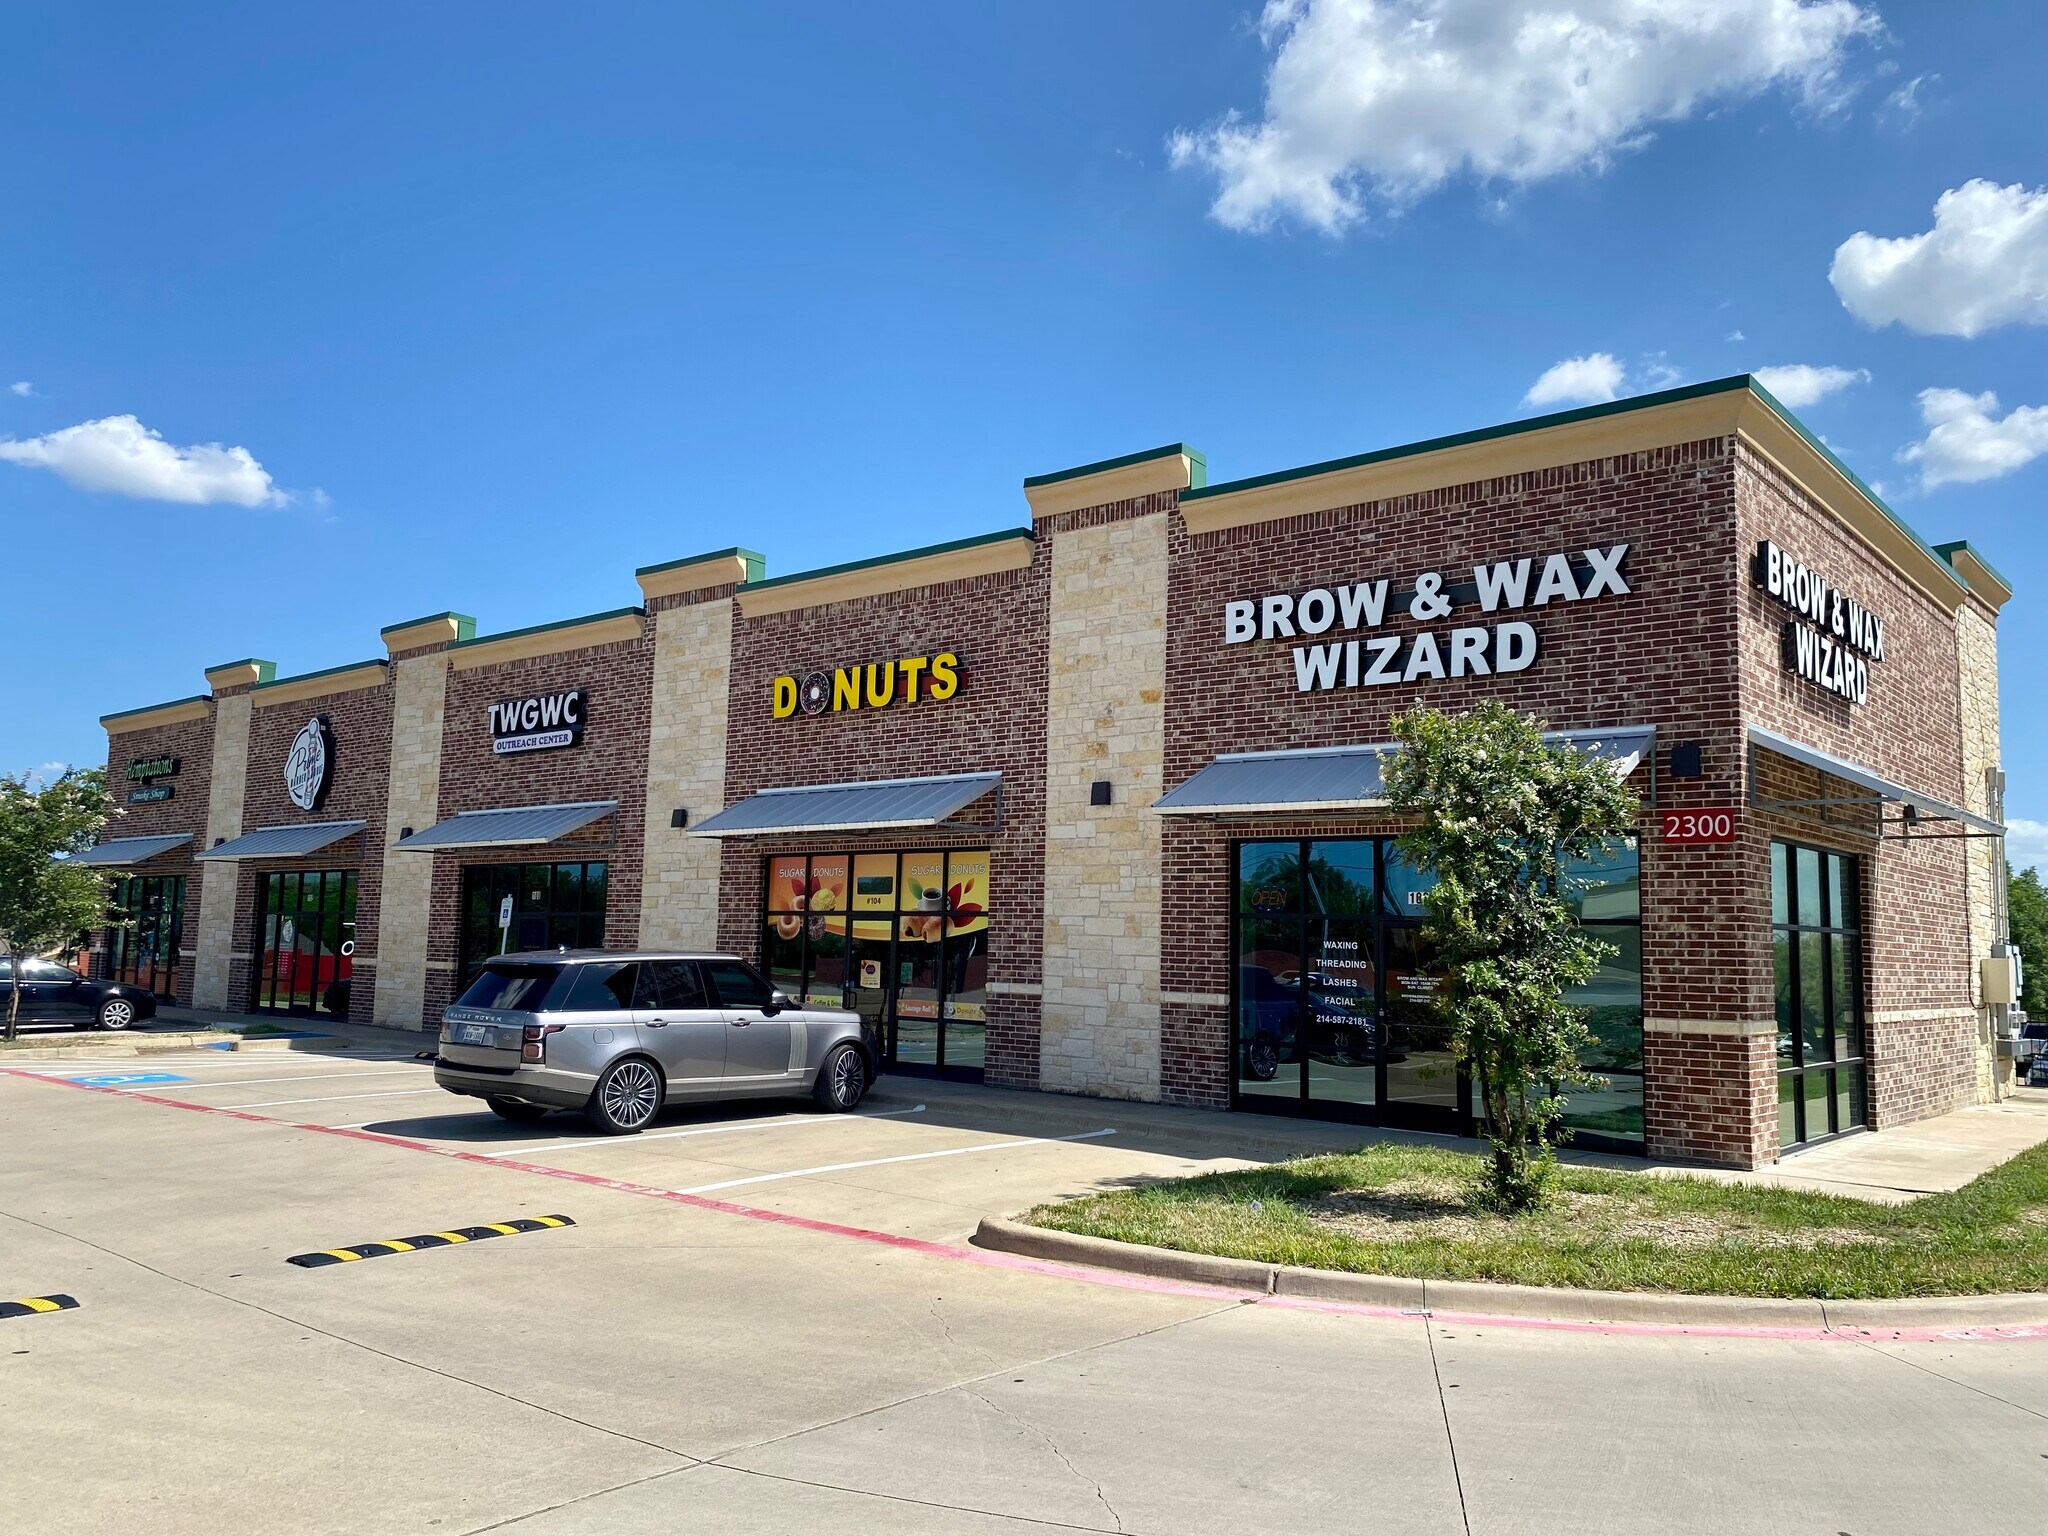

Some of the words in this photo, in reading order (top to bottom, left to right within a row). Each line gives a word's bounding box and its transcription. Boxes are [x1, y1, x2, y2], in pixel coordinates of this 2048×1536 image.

[1225, 579, 1390, 644] BROW
[1409, 572, 1454, 621] &
[1473, 543, 1632, 611] WAX
[1767, 540, 1827, 626] BROW
[1831, 587, 1845, 637] &
[1848, 598, 1886, 663] WAX
[1293, 621, 1538, 692] WIZARD
[1795, 621, 1868, 706] WIZARD
[773, 653, 958, 719] DONUTS
[487, 691, 579, 734] TWGWC
[496, 737, 537, 750] OUTREACH
[538, 733, 569, 745] CENTER
[125, 755, 174, 784] Hemptations
[150, 788, 165, 799] Shop
[1666, 814, 1731, 838] 2300
[779, 867, 806, 878] SUGAR
[813, 867, 844, 877] DONUTS
[911, 865, 942, 876] SUGAR
[950, 864, 986, 876] DONUTS
[866, 897, 882, 905] #104
[1251, 890, 1287, 907] OPEN
[1323, 941, 1359, 950] WAXING
[1316, 959, 1367, 969] THREADING
[1323, 978, 1358, 988] LASHES
[1324, 996, 1356, 1006] FACIAL
[474, 1014, 502, 1022] ROVER
[1316, 1015, 1367, 1026] 214-587-2181
